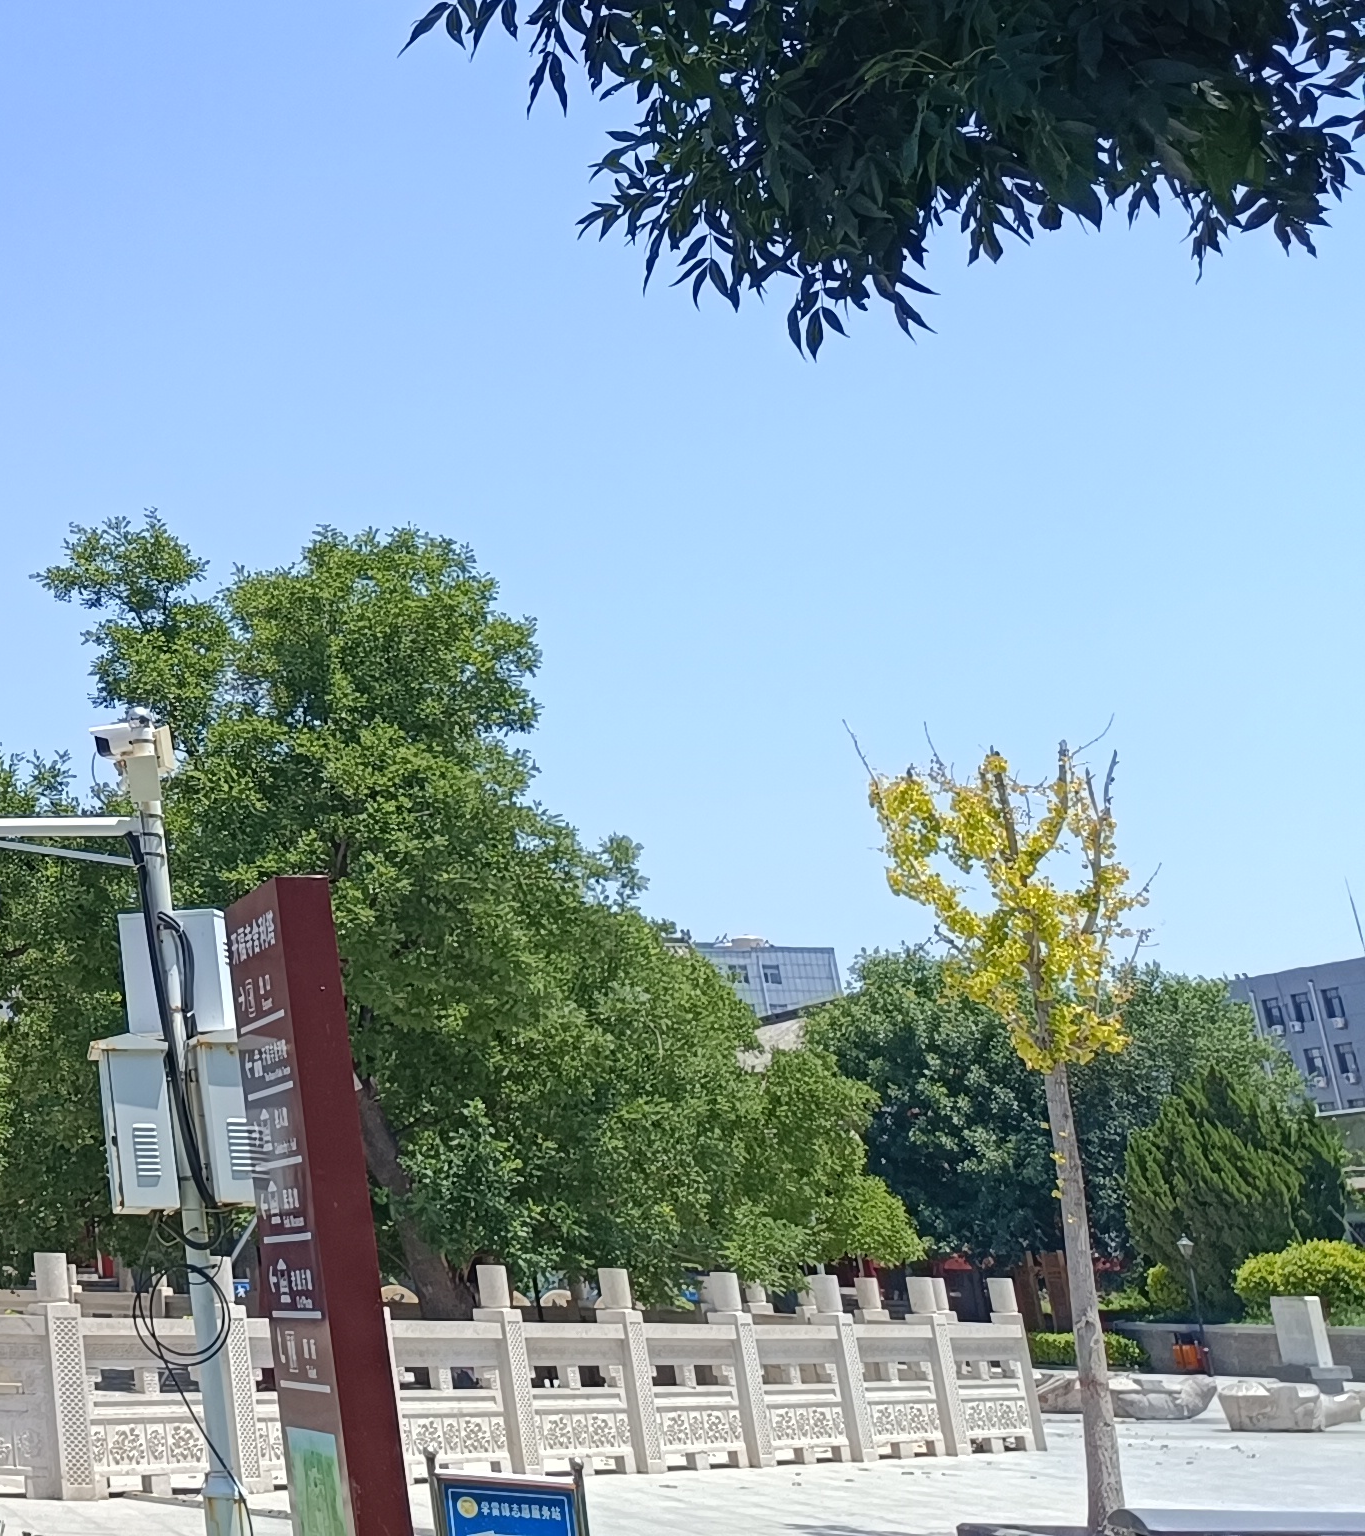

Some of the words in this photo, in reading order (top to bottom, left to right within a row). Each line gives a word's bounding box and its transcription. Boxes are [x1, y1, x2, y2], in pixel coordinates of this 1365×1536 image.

[231, 910, 275, 965] 开福寺舍利塔
